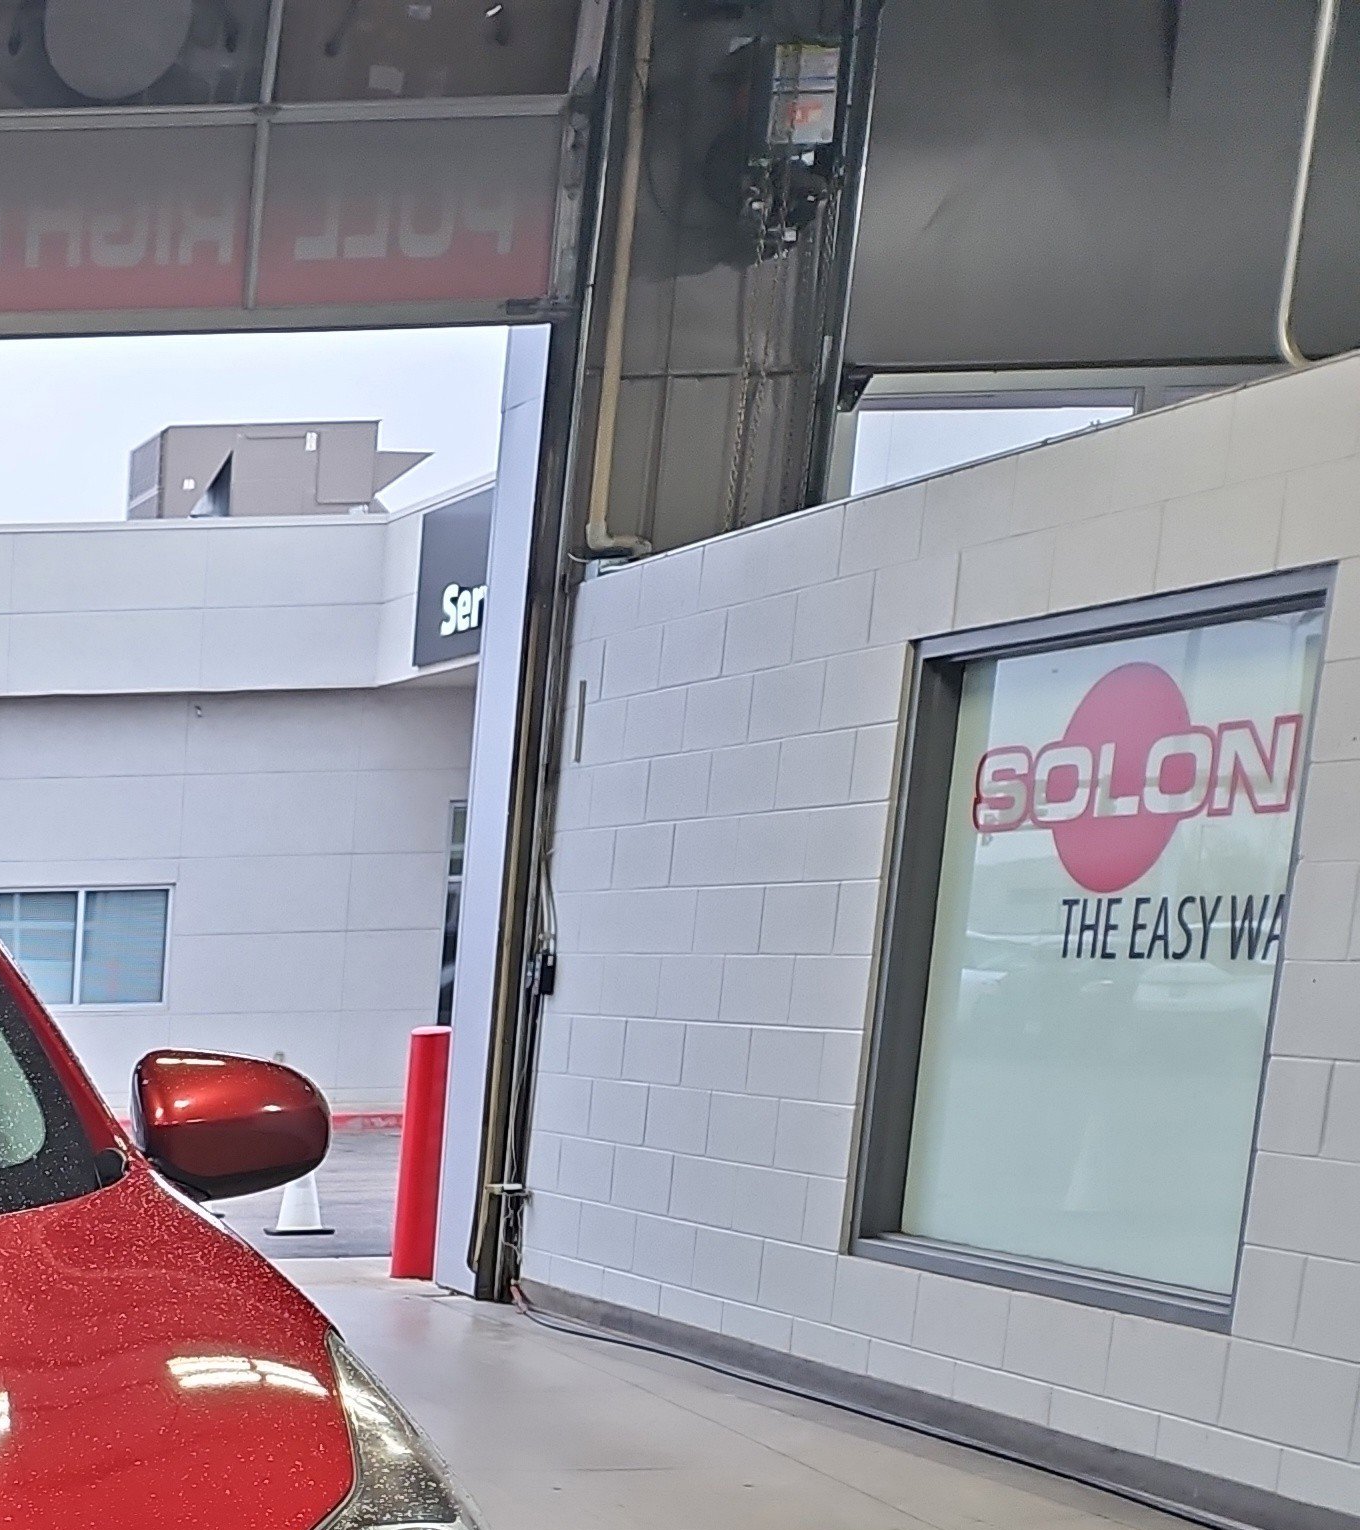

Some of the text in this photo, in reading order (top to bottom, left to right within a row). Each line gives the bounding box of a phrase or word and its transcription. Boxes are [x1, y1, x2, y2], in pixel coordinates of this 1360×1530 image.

[973, 714, 1302, 832] SOLON
[1062, 897, 1121, 959] THE
[1128, 895, 1222, 961] EASY
